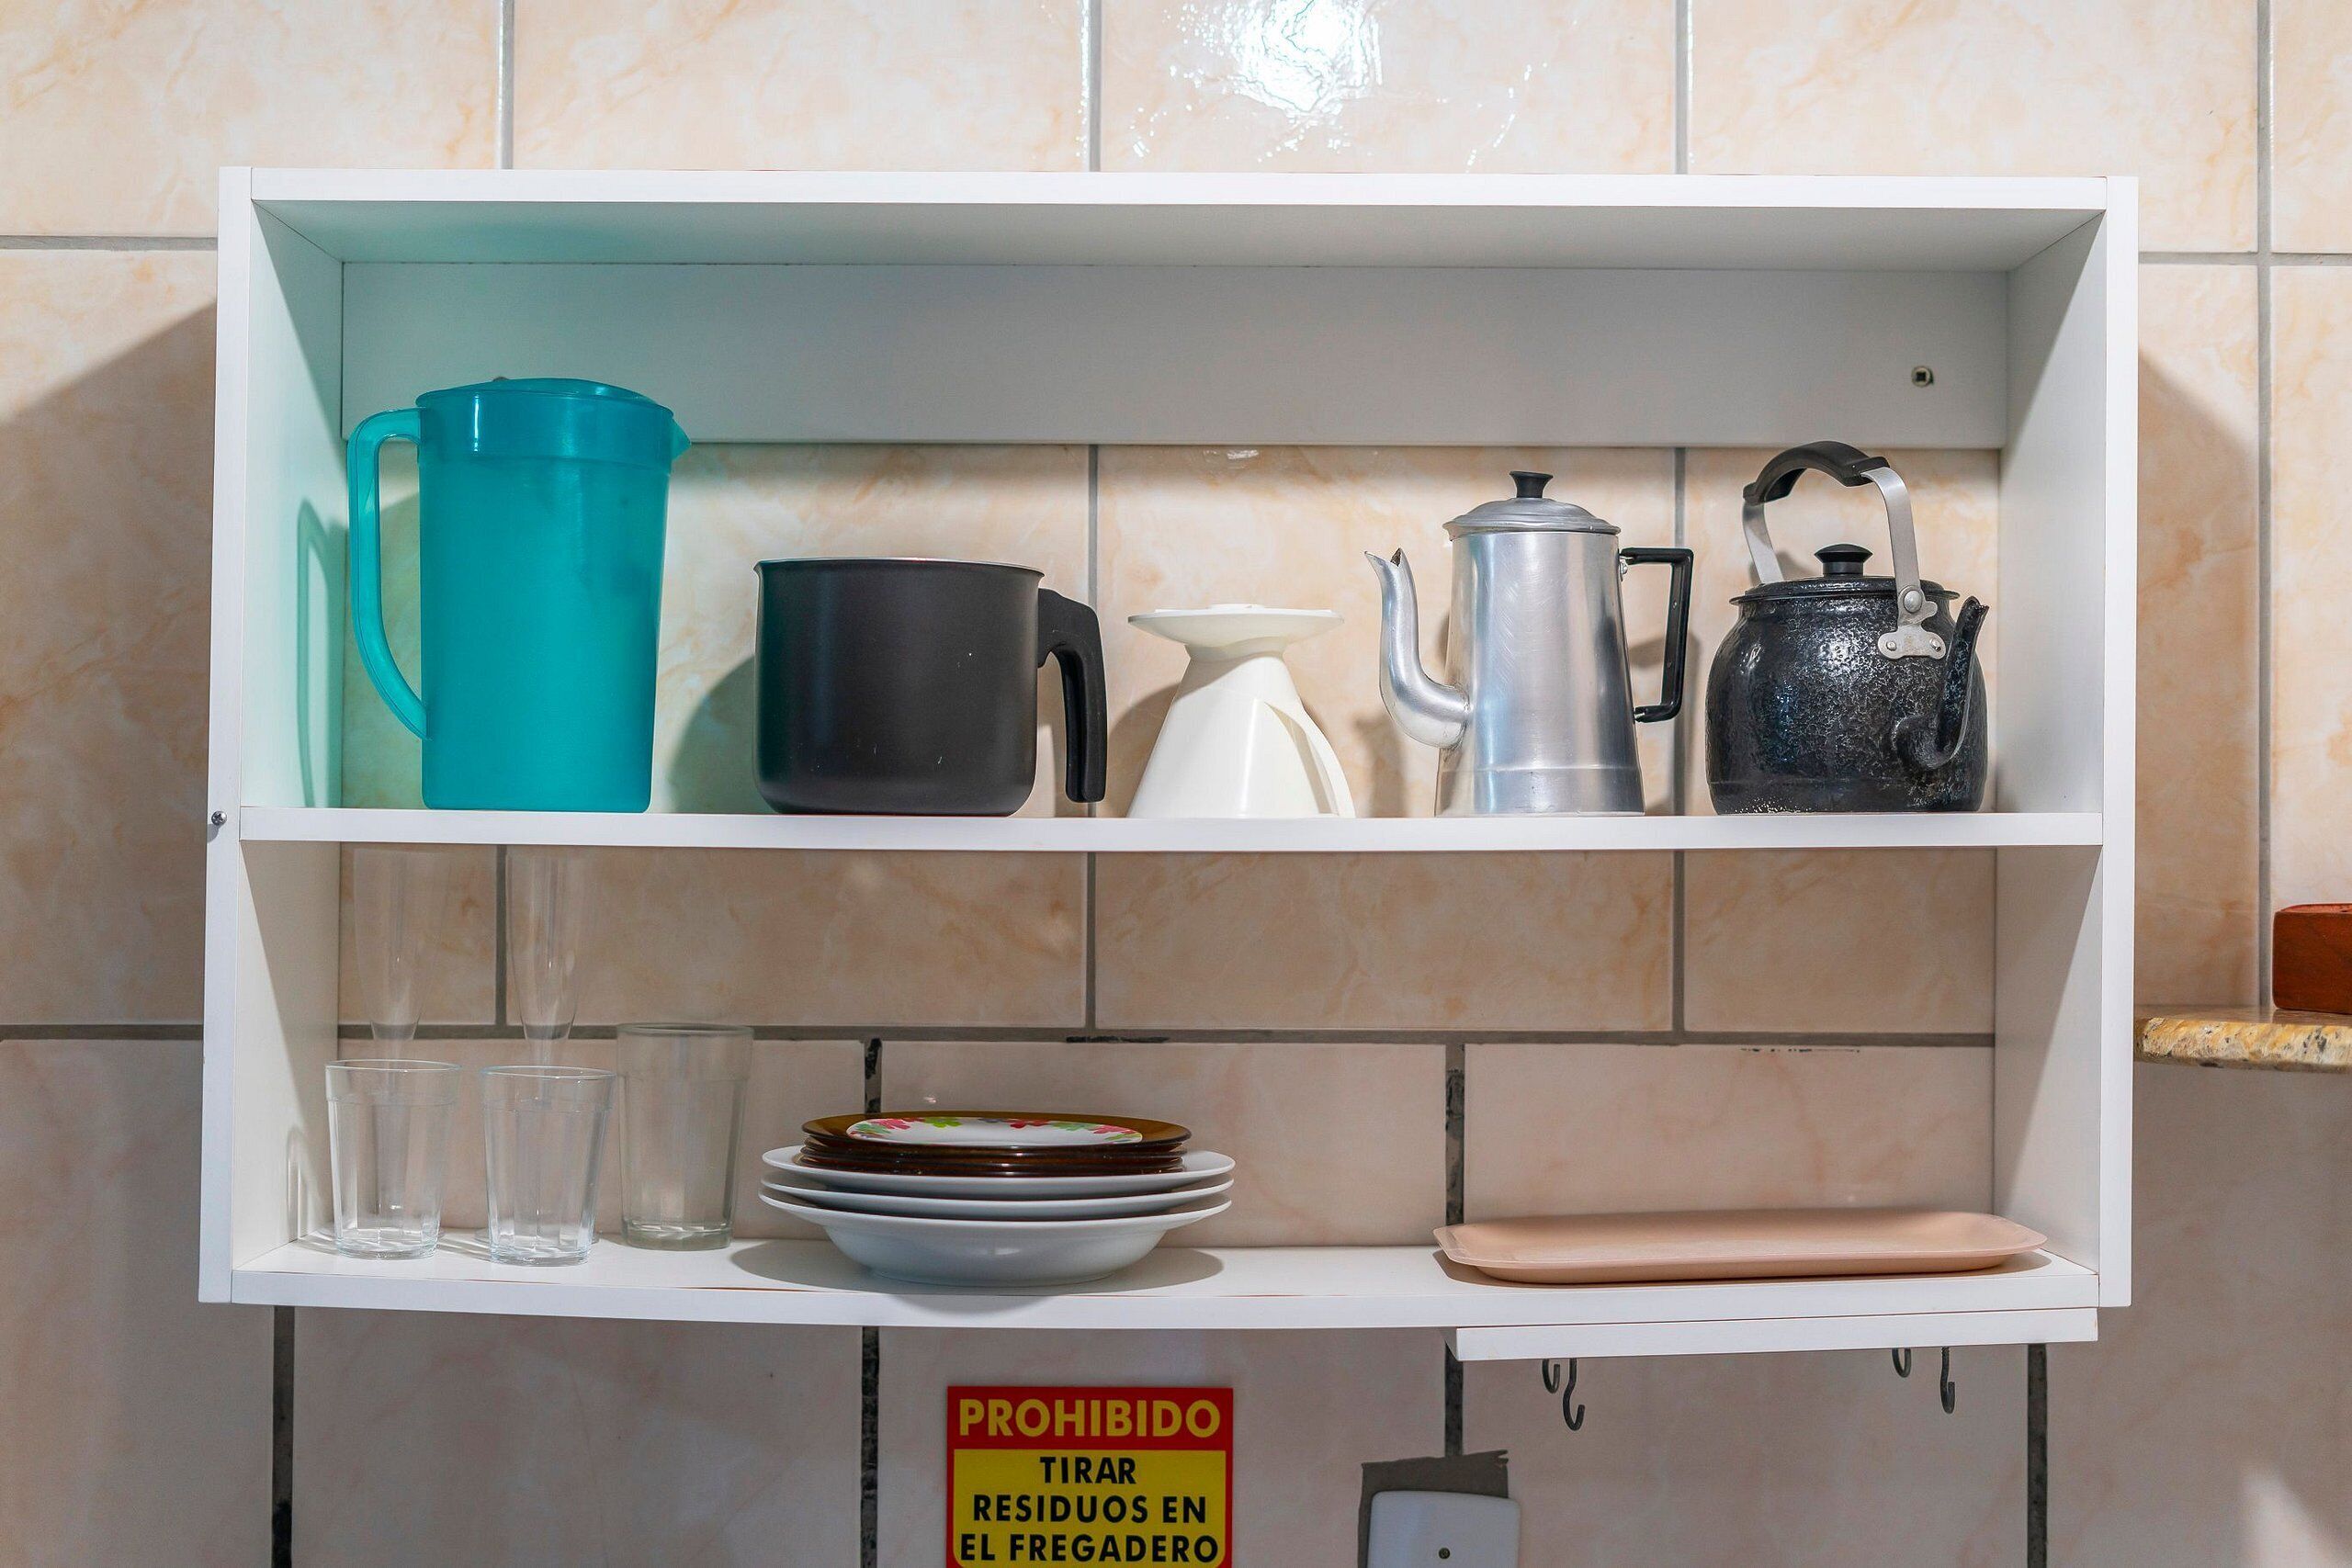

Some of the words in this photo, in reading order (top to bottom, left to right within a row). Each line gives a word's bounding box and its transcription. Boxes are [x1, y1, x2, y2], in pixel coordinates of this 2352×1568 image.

[959, 1399, 1221, 1438] PROHIBIDO
[1040, 1456, 1136, 1484] TIRAR
[973, 1494, 1148, 1524] RESIDUOS
[1162, 1495, 1206, 1524] EN
[960, 1533, 996, 1562] EL
[1010, 1533, 1218, 1563] FREGADERO
